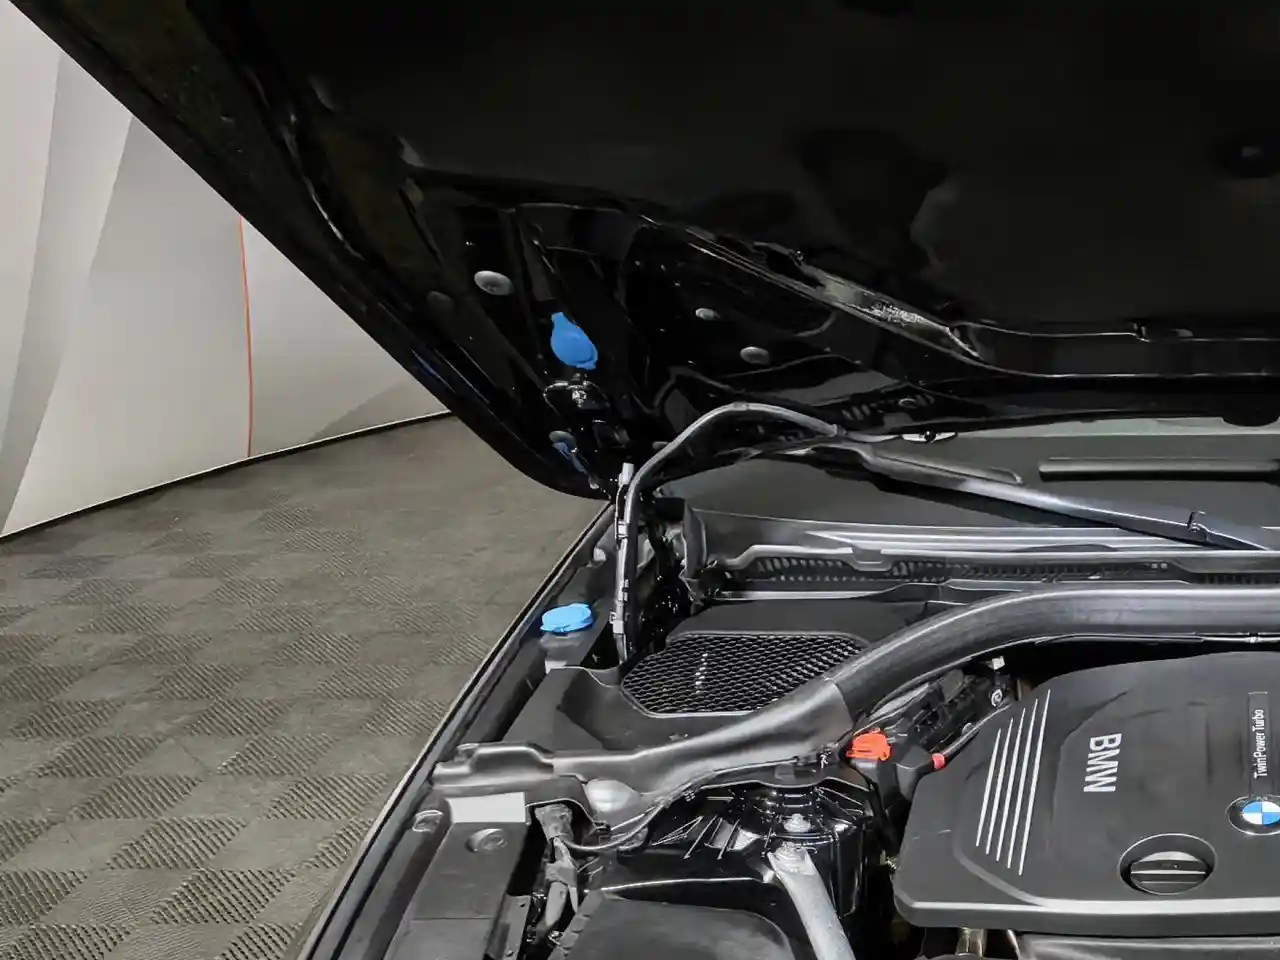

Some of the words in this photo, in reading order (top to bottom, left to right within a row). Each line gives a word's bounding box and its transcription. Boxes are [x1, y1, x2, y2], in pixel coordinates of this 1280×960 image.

[1252, 709, 1265, 732] Turbo
[1083, 733, 1122, 792] BMW
[1252, 732, 1268, 779] TwinPower
